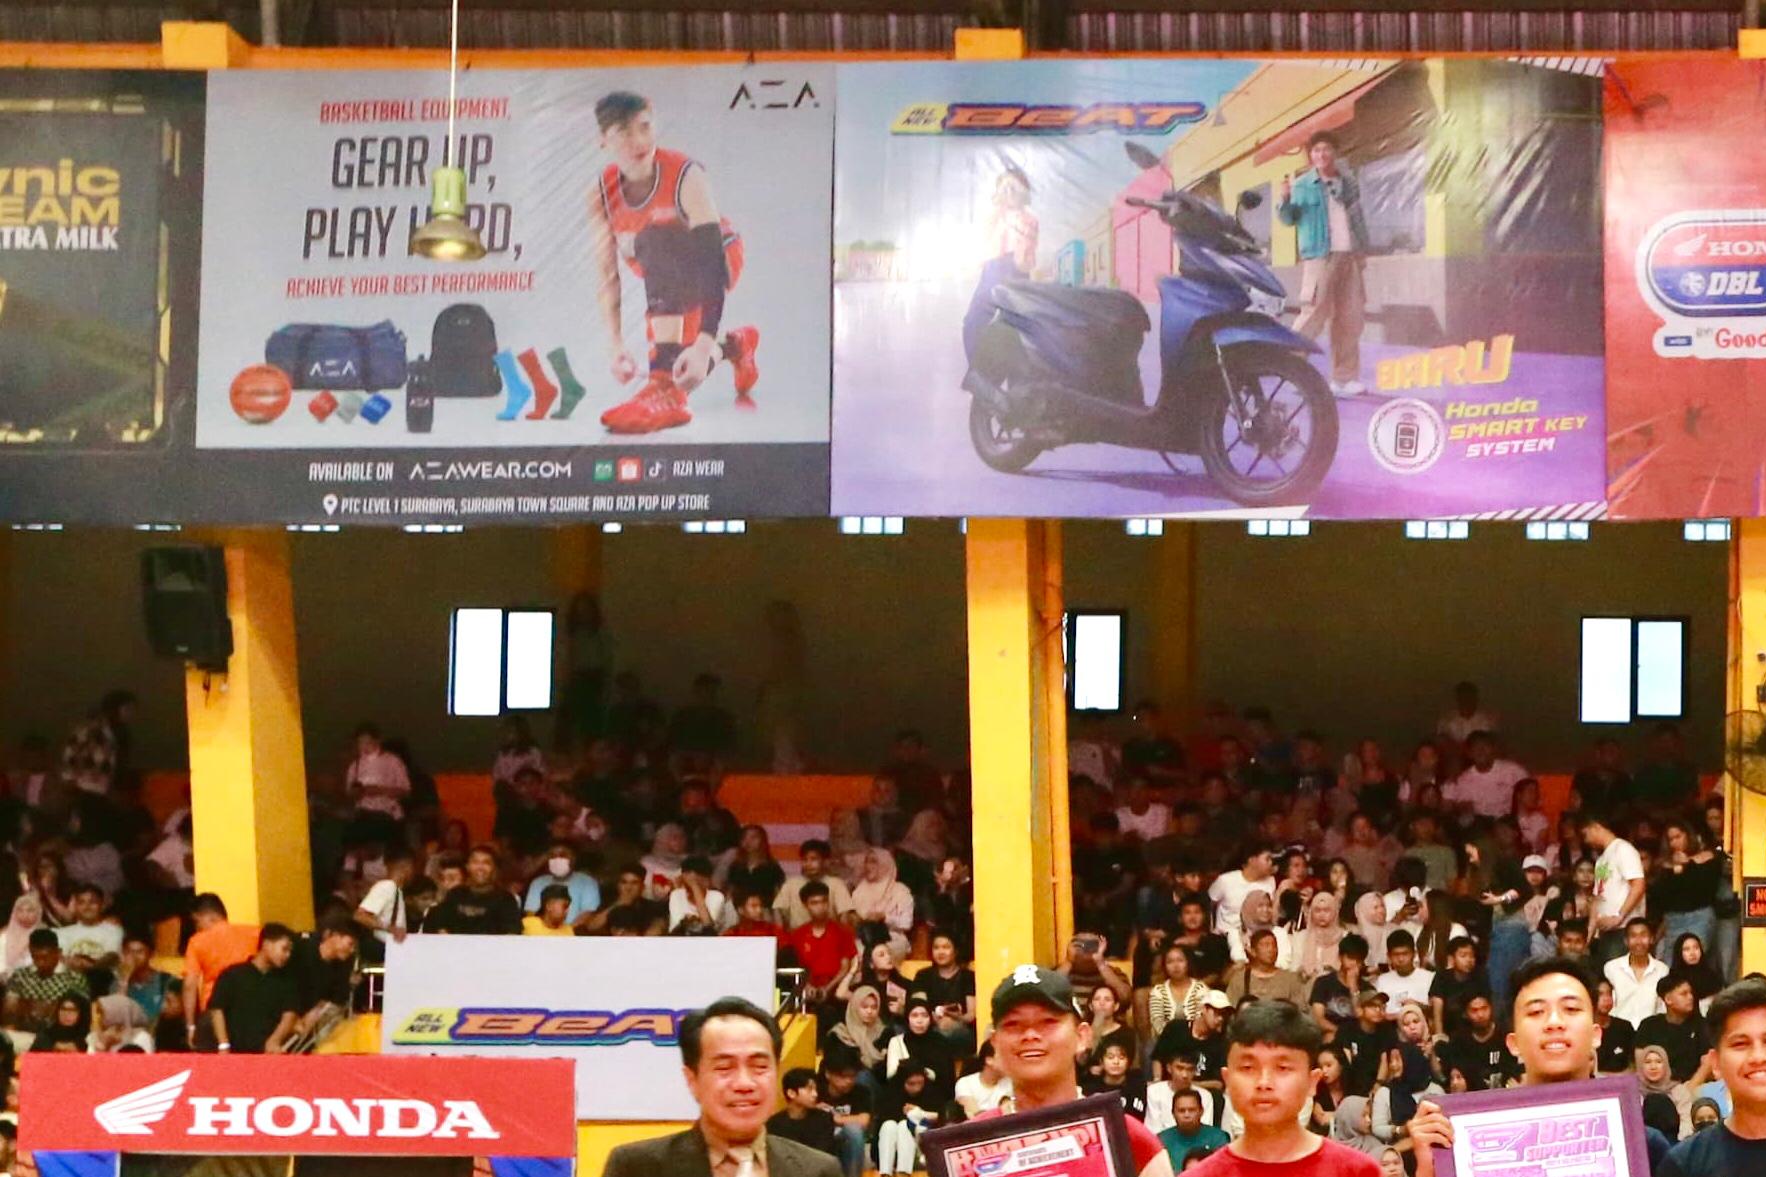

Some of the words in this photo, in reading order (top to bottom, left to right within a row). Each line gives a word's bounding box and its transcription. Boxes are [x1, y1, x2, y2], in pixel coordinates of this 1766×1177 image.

[320, 99, 415, 123] BASKETBALL
[332, 135, 430, 189] GEAR
[55, 225, 120, 251] MILK
[303, 205, 397, 259] PLAY
[286, 277, 345, 298] ACHIEVE
[351, 276, 389, 296] YOUR
[393, 275, 428, 294] BEST
[432, 271, 536, 295] PERFORMANCE
[1707, 271, 1765, 297] DBL
[1375, 334, 1516, 391] BARU
[1446, 397, 1540, 420] Honda
[1448, 417, 1541, 441] SMART
[1544, 415, 1589, 435] KEY
[1465, 436, 1556, 458] SYSTEM
[309, 462, 373, 481] AVAILABLE
[376, 462, 394, 480] ON
[696, 459, 725, 477] WEAR
[363, 497, 391, 514] LEVEL
[517, 495, 548, 513] TOWN
[549, 495, 590, 513] SQUARE
[592, 494, 613, 512] AND
[638, 493, 660, 511] POP
[661, 492, 675, 511] UP
[678, 493, 710, 511] STORE
[406, 1023, 443, 1034] NEW
[413, 1013, 445, 1023] ALL
[455, 1011, 685, 1037] BeA
[188, 1096, 500, 1140] HONDA
